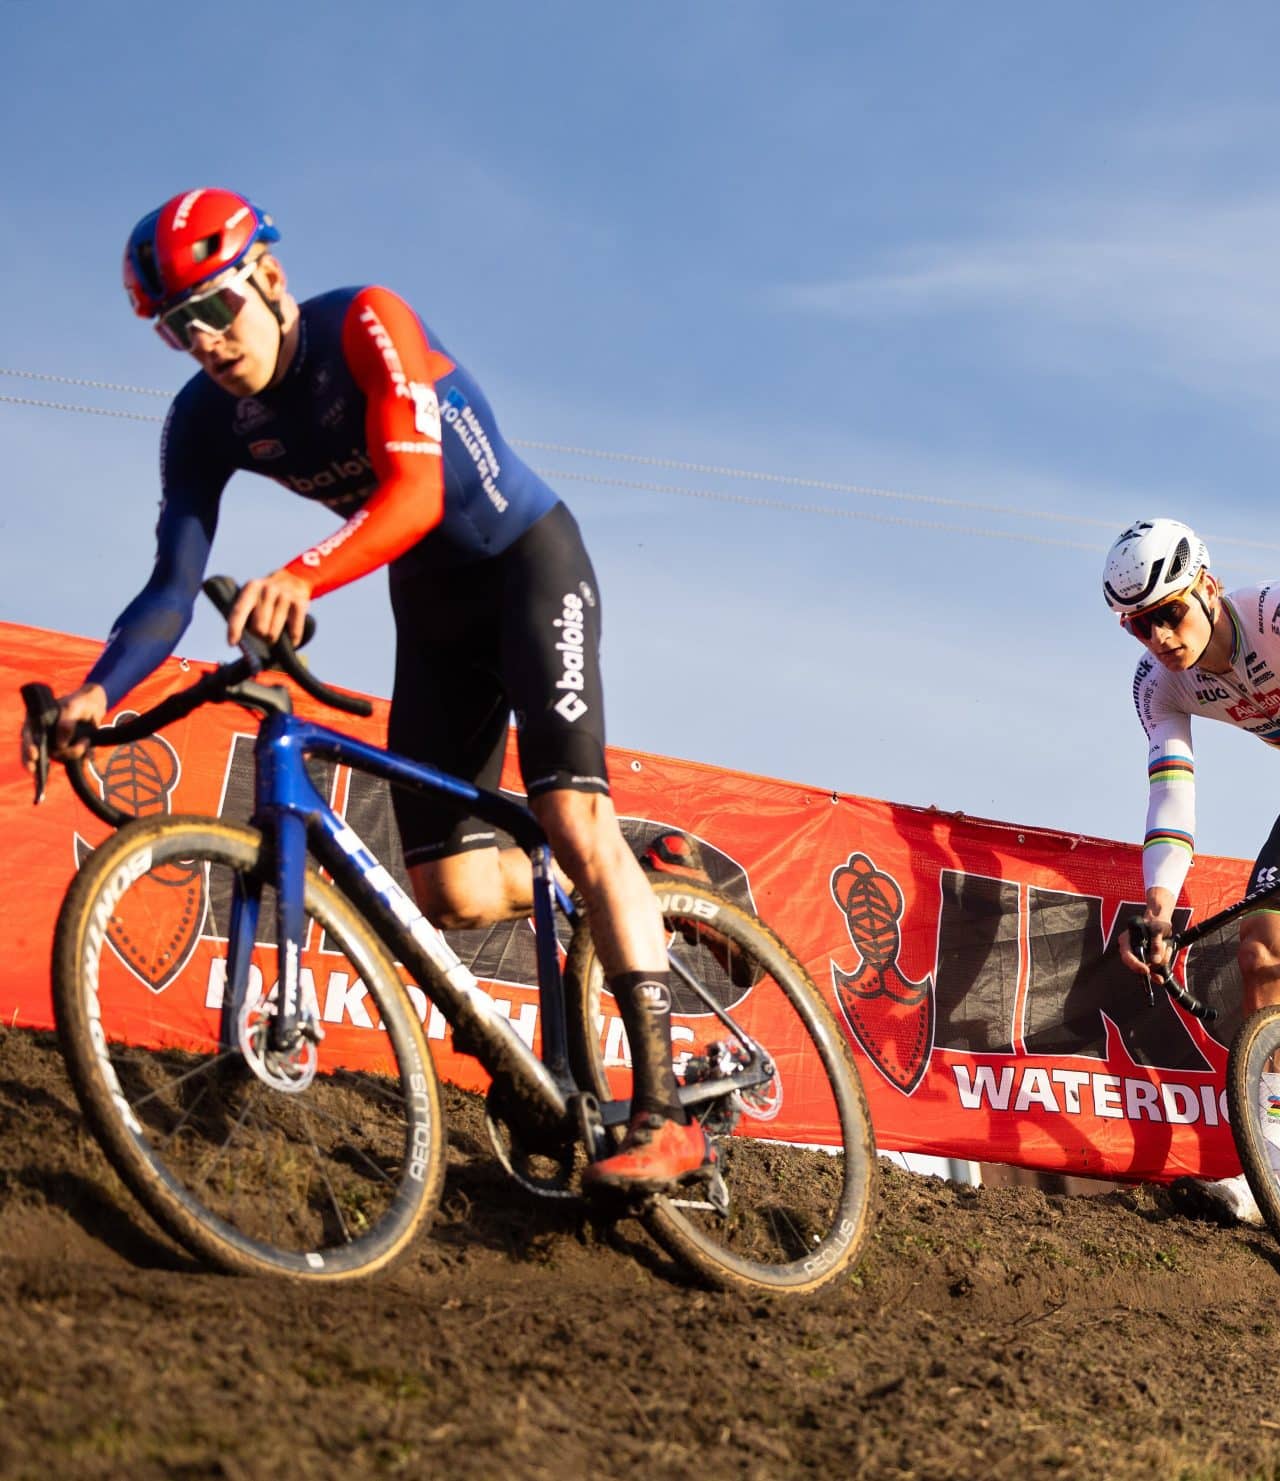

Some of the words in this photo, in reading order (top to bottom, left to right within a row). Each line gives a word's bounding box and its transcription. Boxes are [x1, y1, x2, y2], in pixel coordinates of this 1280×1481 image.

[360, 305, 412, 398] TREK
[555, 593, 584, 690] baloise
[1143, 687, 1154, 721] WINDOWS
[409, 1072, 432, 1182] AEOLUS
